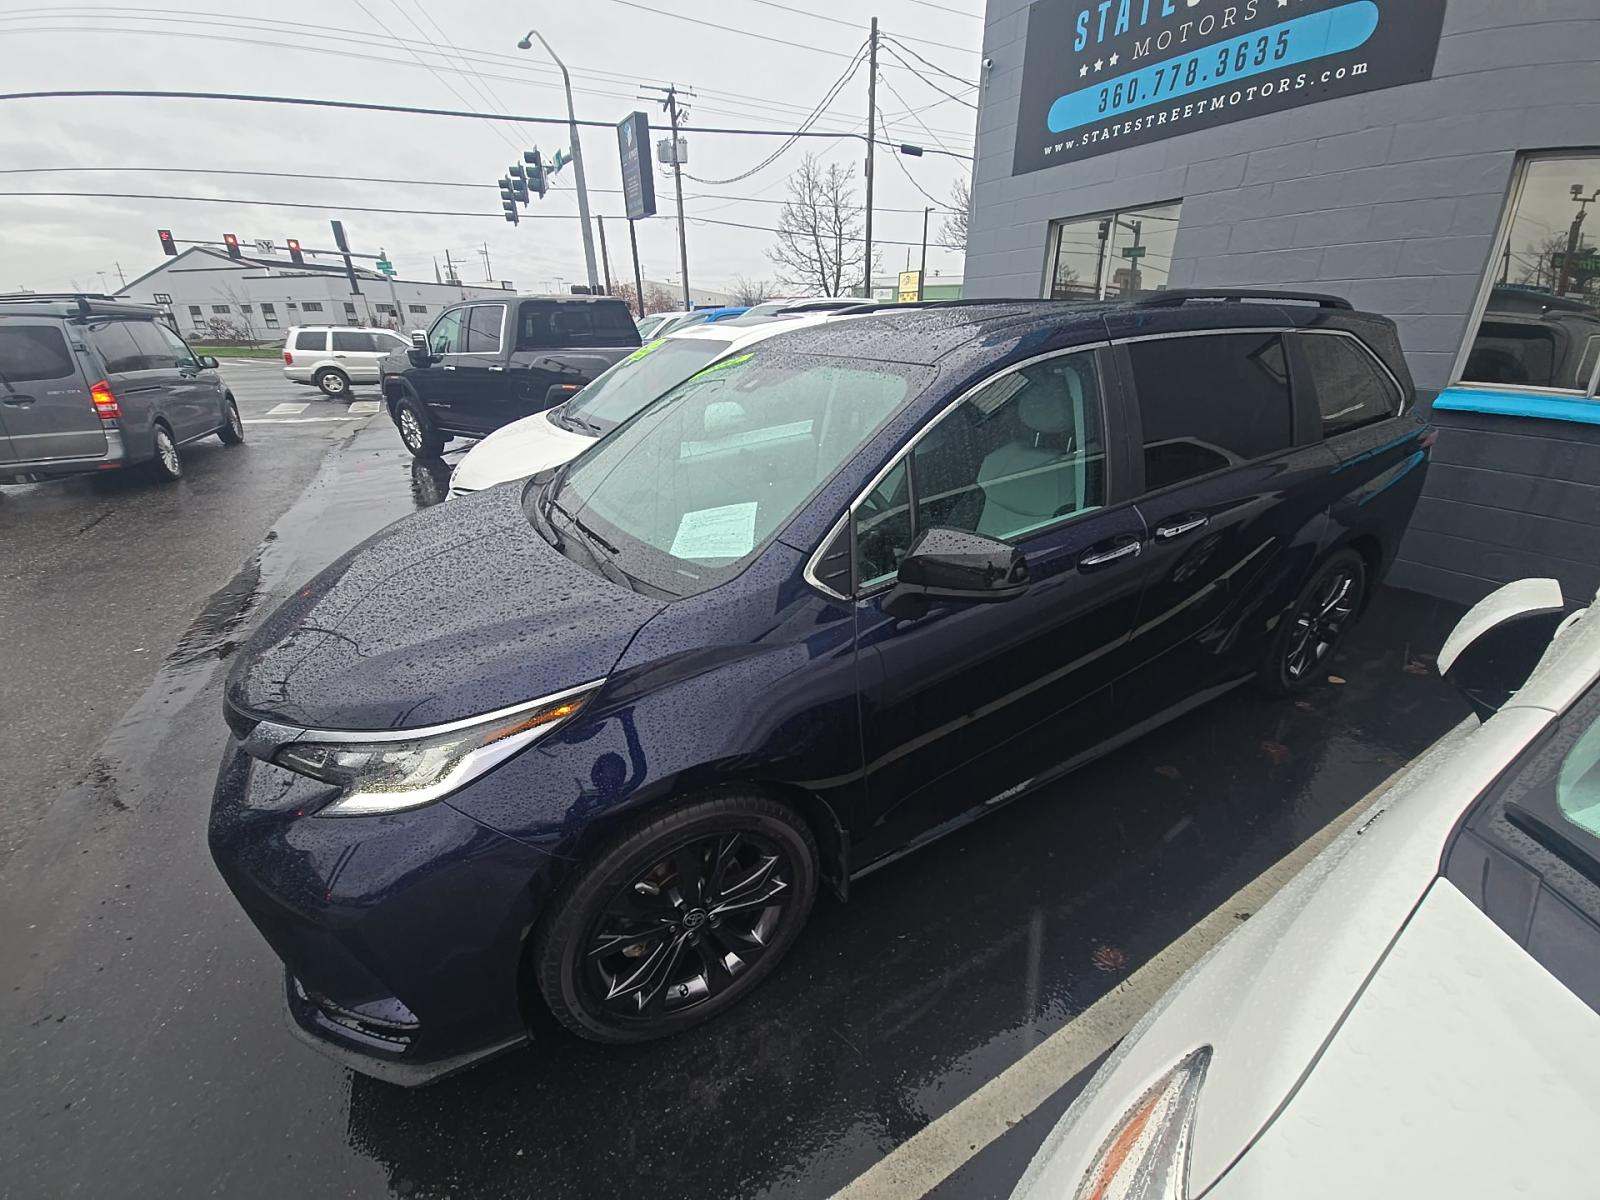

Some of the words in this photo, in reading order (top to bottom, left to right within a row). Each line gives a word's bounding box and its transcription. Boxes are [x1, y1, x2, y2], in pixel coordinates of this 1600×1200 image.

[1098, 29, 1291, 113] 360.778.3635
[1132, 0, 1258, 61] MOTORS
[1043, 62, 1369, 155] www.STATESTREETMOTORS.com
